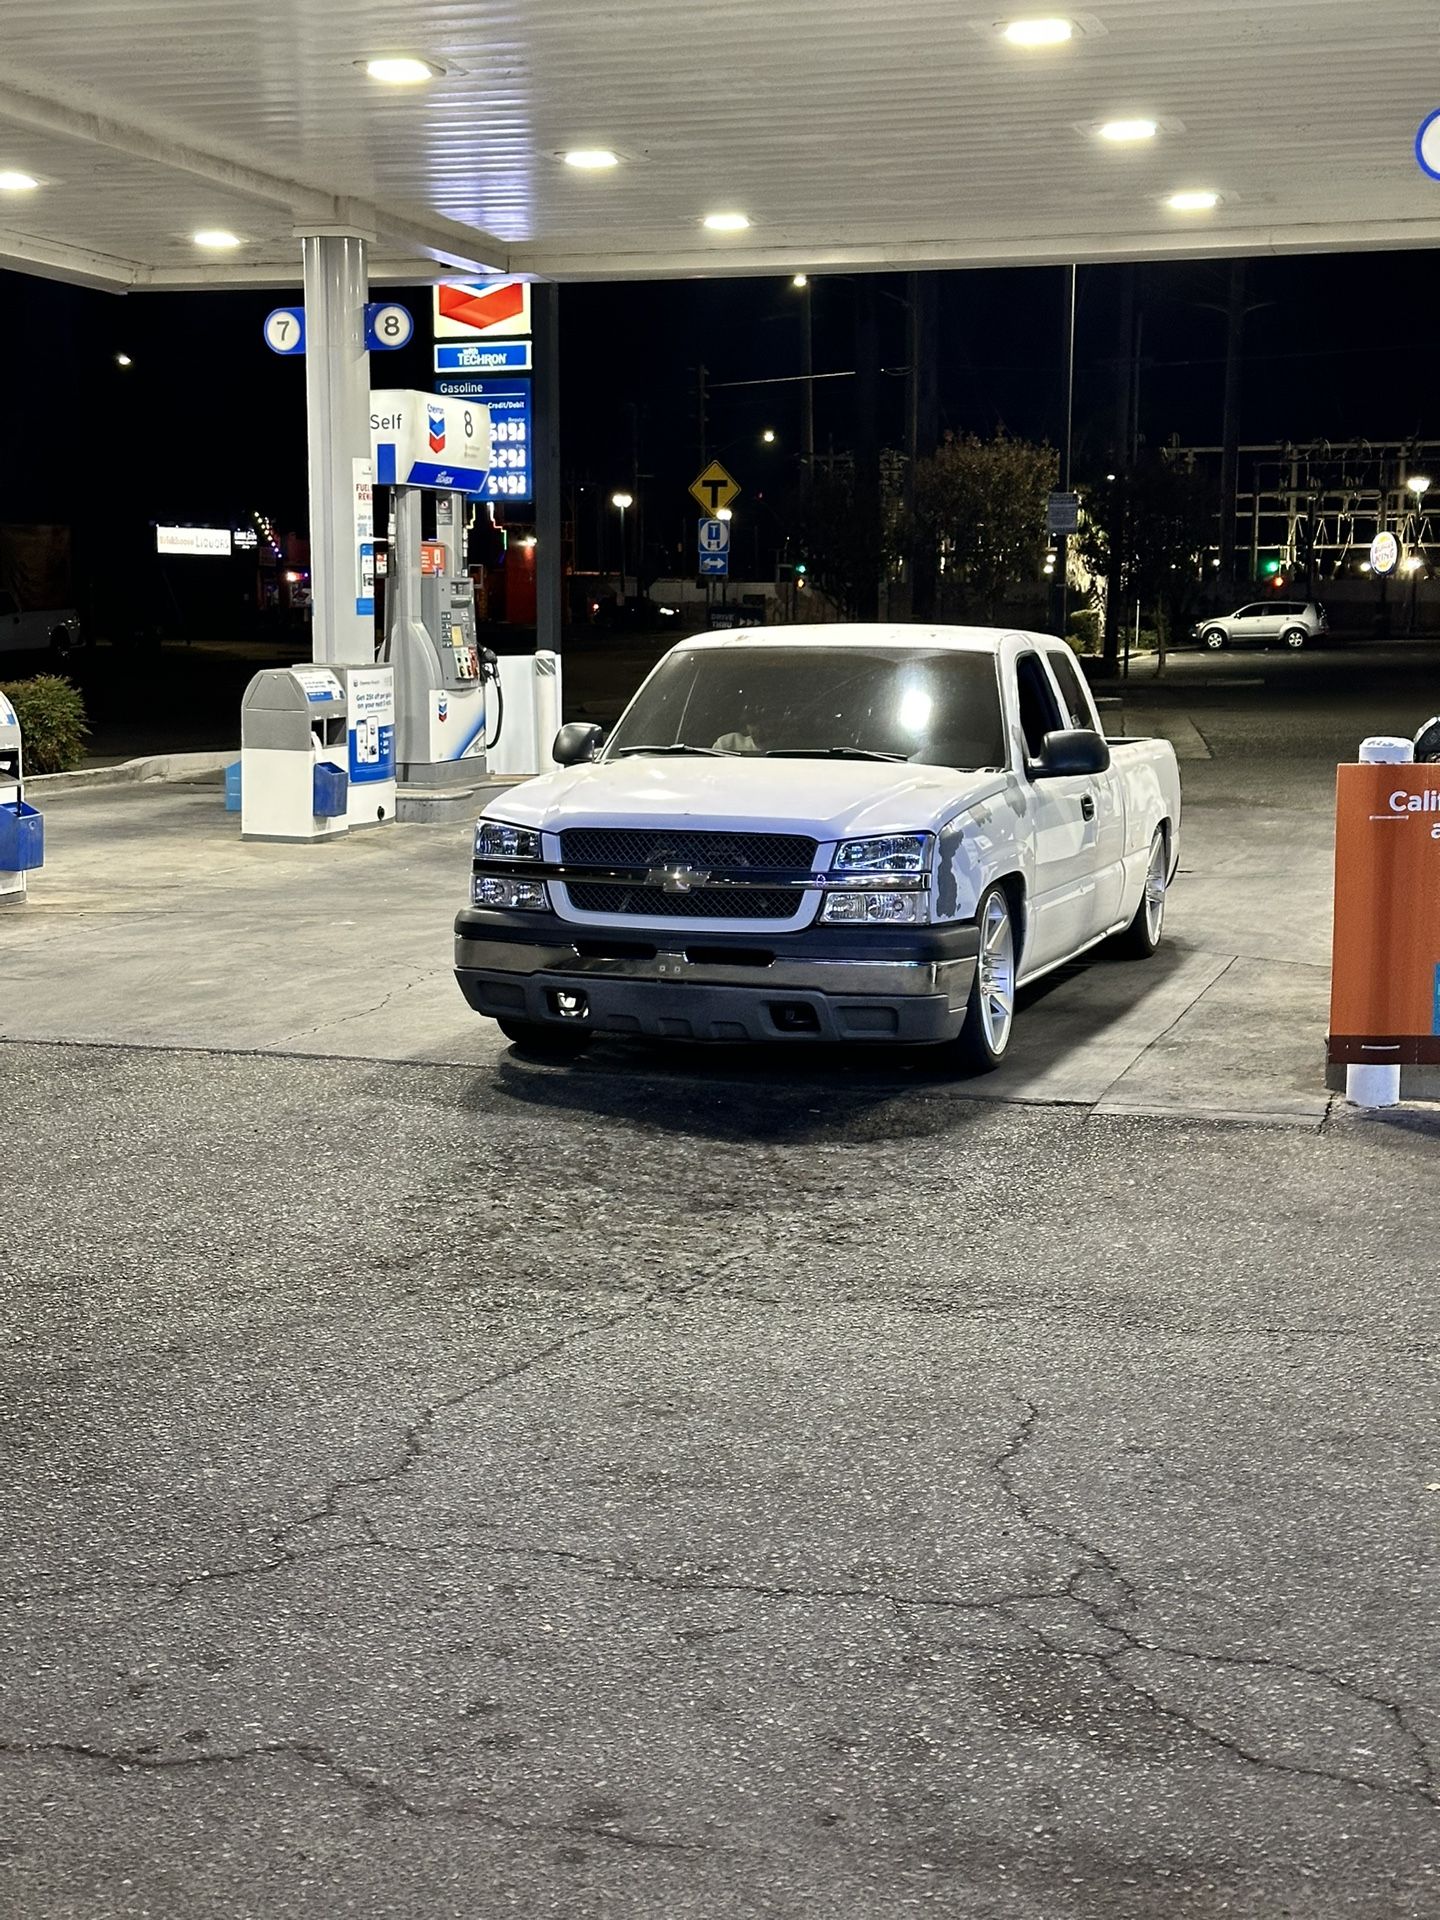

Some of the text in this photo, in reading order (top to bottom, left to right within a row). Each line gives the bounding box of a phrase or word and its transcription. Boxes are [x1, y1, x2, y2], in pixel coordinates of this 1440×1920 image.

[276, 320, 290, 341] 7
[384, 315, 400, 337] 8
[457, 353, 507, 366] TECHRON
[440, 382, 483, 393] Gasoline
[487, 401, 525, 409] Credit/Debit
[370, 413, 402, 430] Self
[464, 410, 473, 438] 8
[195, 535, 230, 549] LIQUORS
[356, 694, 365, 702] Get
